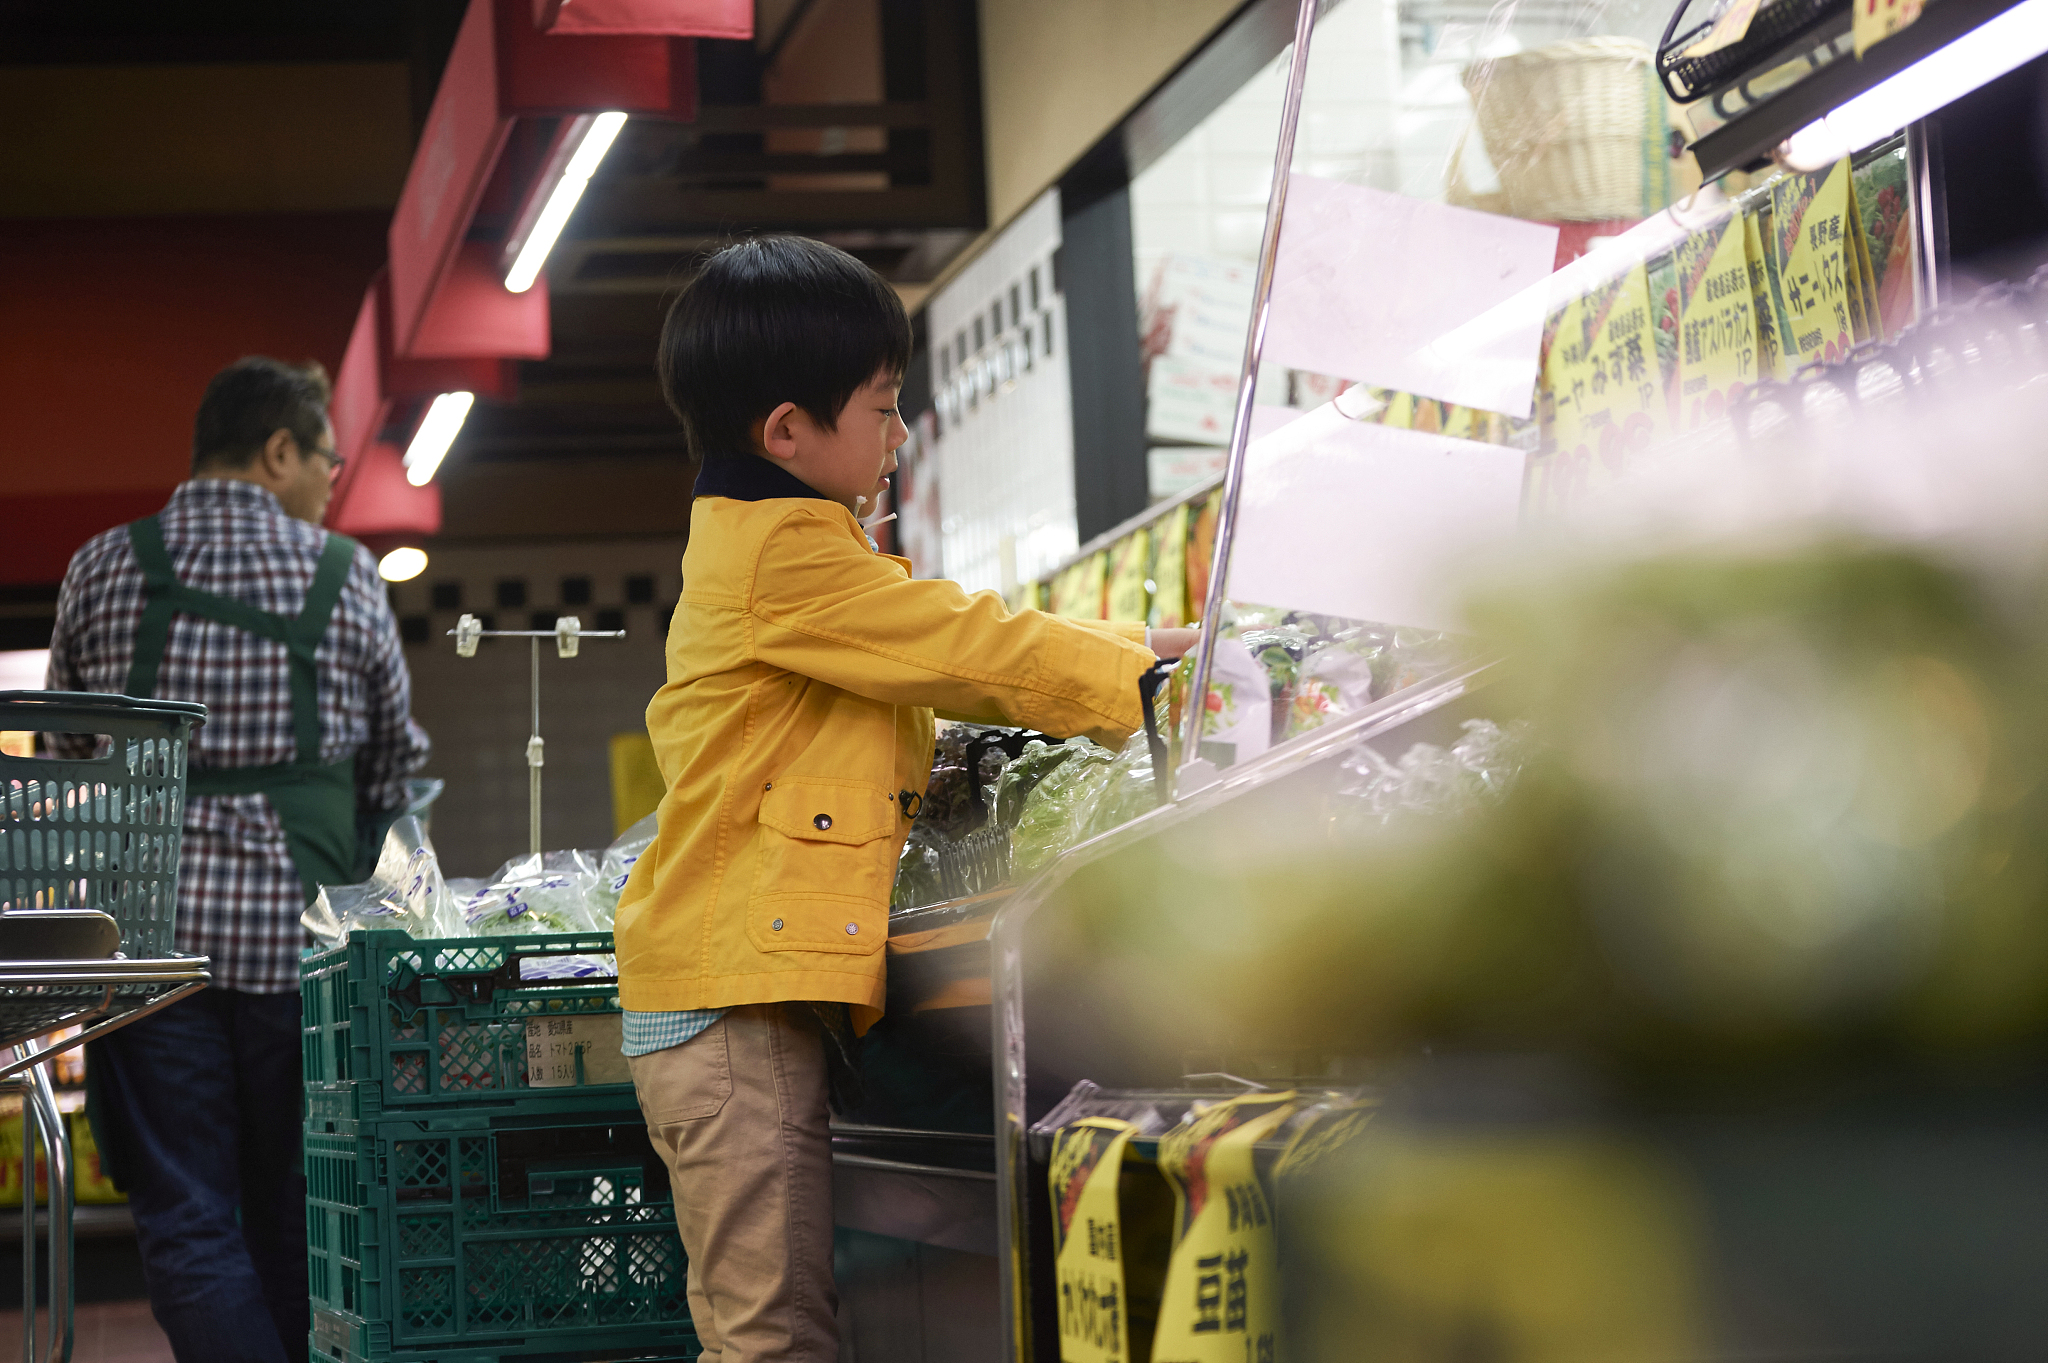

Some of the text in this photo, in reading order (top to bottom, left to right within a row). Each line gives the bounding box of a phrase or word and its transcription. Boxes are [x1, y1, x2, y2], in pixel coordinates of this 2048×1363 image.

[1787, 251, 1843, 318] サニーレタス
[1591, 333, 1646, 395] みず菜
[1736, 348, 1752, 377] 1P
[548, 1020, 573, 1036] 愛知県産
[529, 1044, 542, 1058] 品名
[530, 1064, 575, 1081] 入数 15入り
